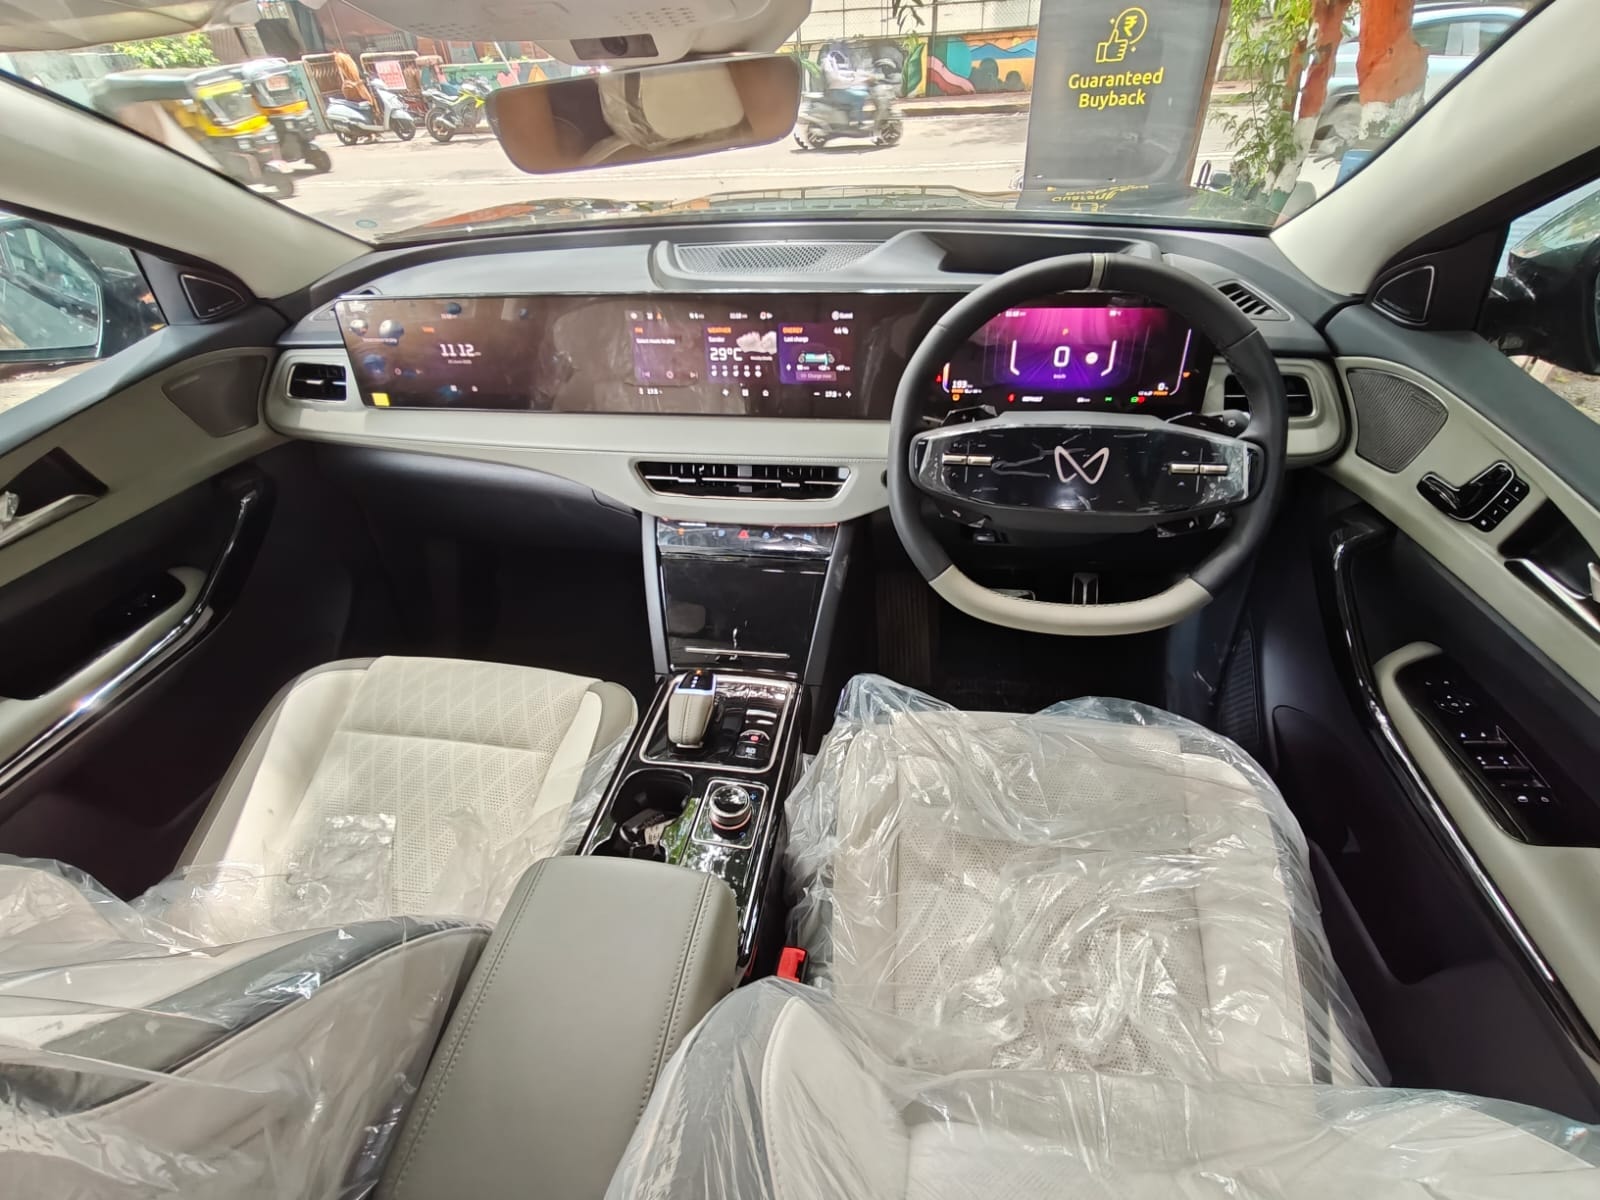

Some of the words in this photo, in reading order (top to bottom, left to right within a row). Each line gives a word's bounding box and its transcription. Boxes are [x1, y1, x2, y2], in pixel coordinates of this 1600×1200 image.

[1068, 66, 1165, 89] Guaranteed
[1078, 88, 1146, 110] Buyback
[1053, 345, 1071, 368] 0
